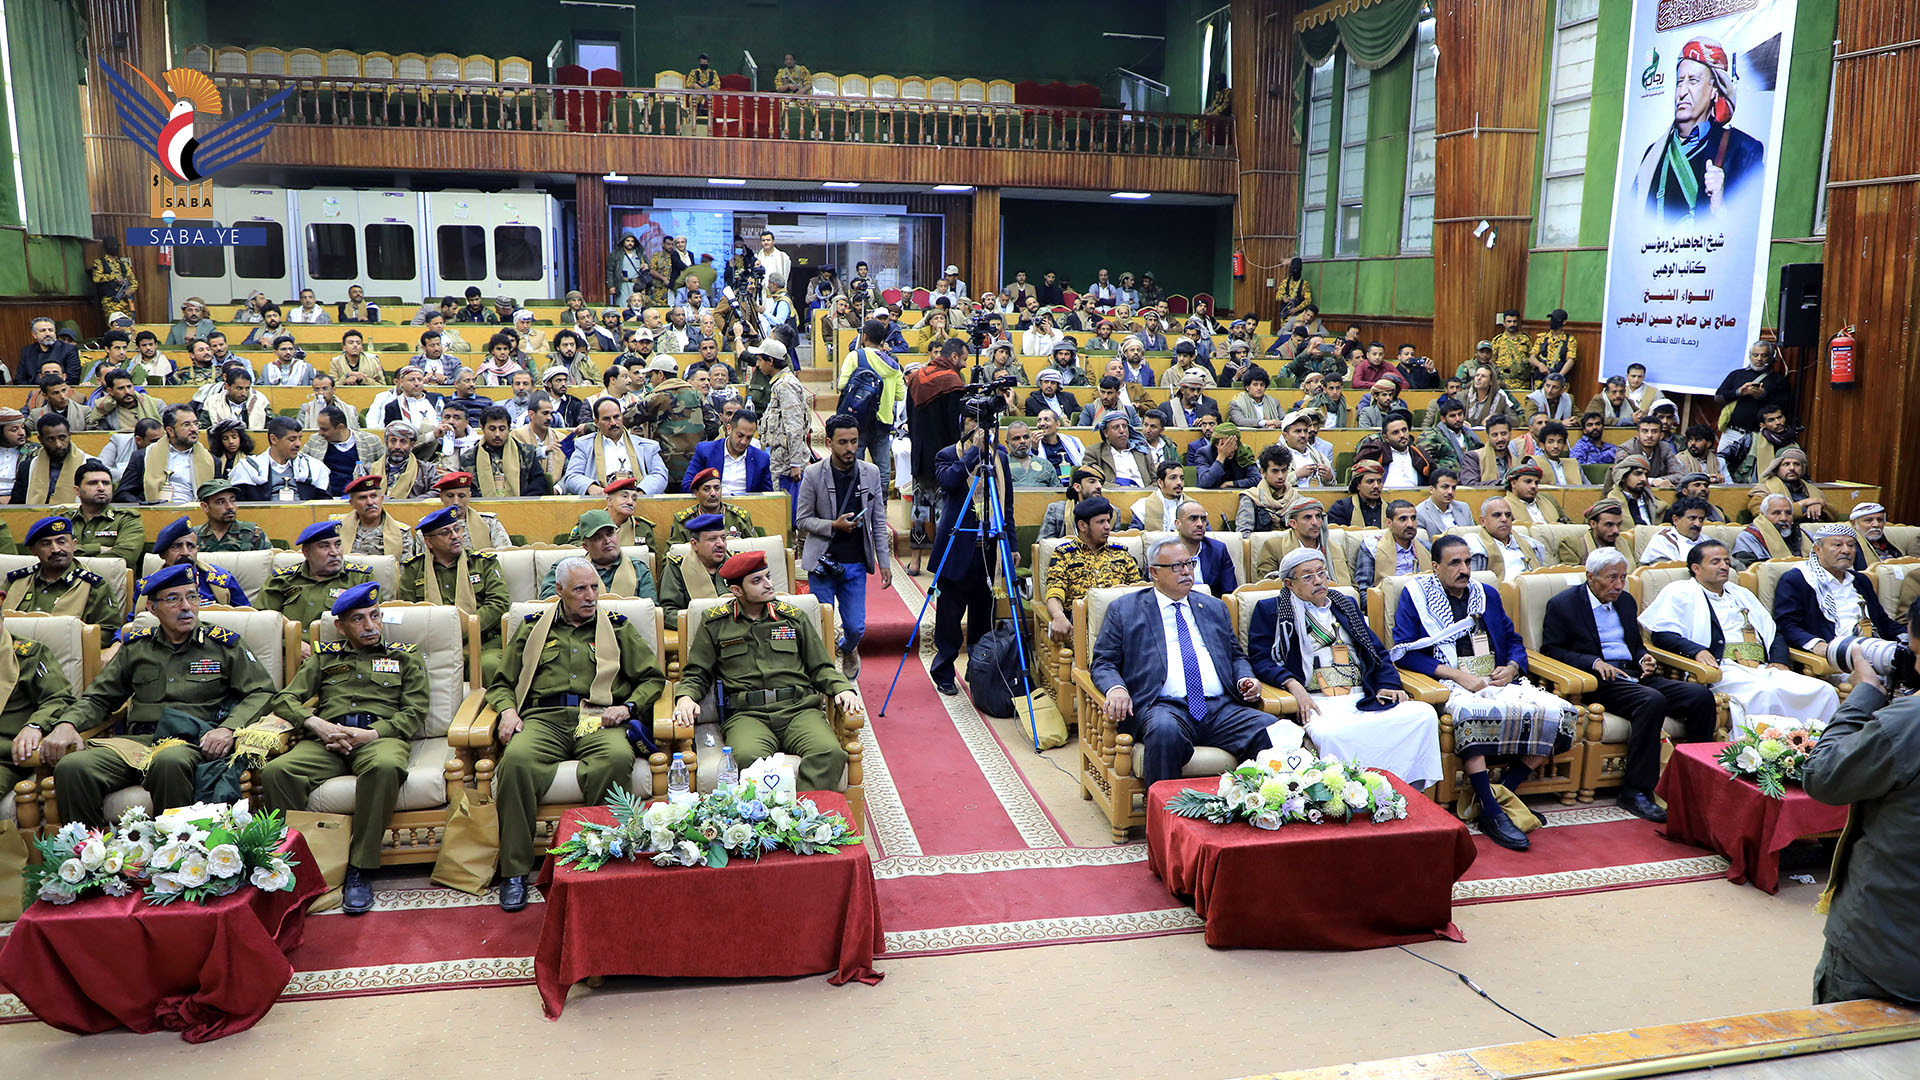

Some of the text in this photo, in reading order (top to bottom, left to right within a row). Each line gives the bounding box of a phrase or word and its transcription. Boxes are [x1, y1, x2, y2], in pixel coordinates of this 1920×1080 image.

[1641, 232, 1725, 254] شيخ المجاهدين ومؤسس
[1652, 260, 1707, 280] كتائب الوهبي
[1643, 288, 1714, 304] اللواء الشيخ
[1616, 312, 1736, 329] صالح بن صالح حسين الوهبي
[1669, 336, 1681, 346] الله
[1680, 337, 1699, 348] رحمة
